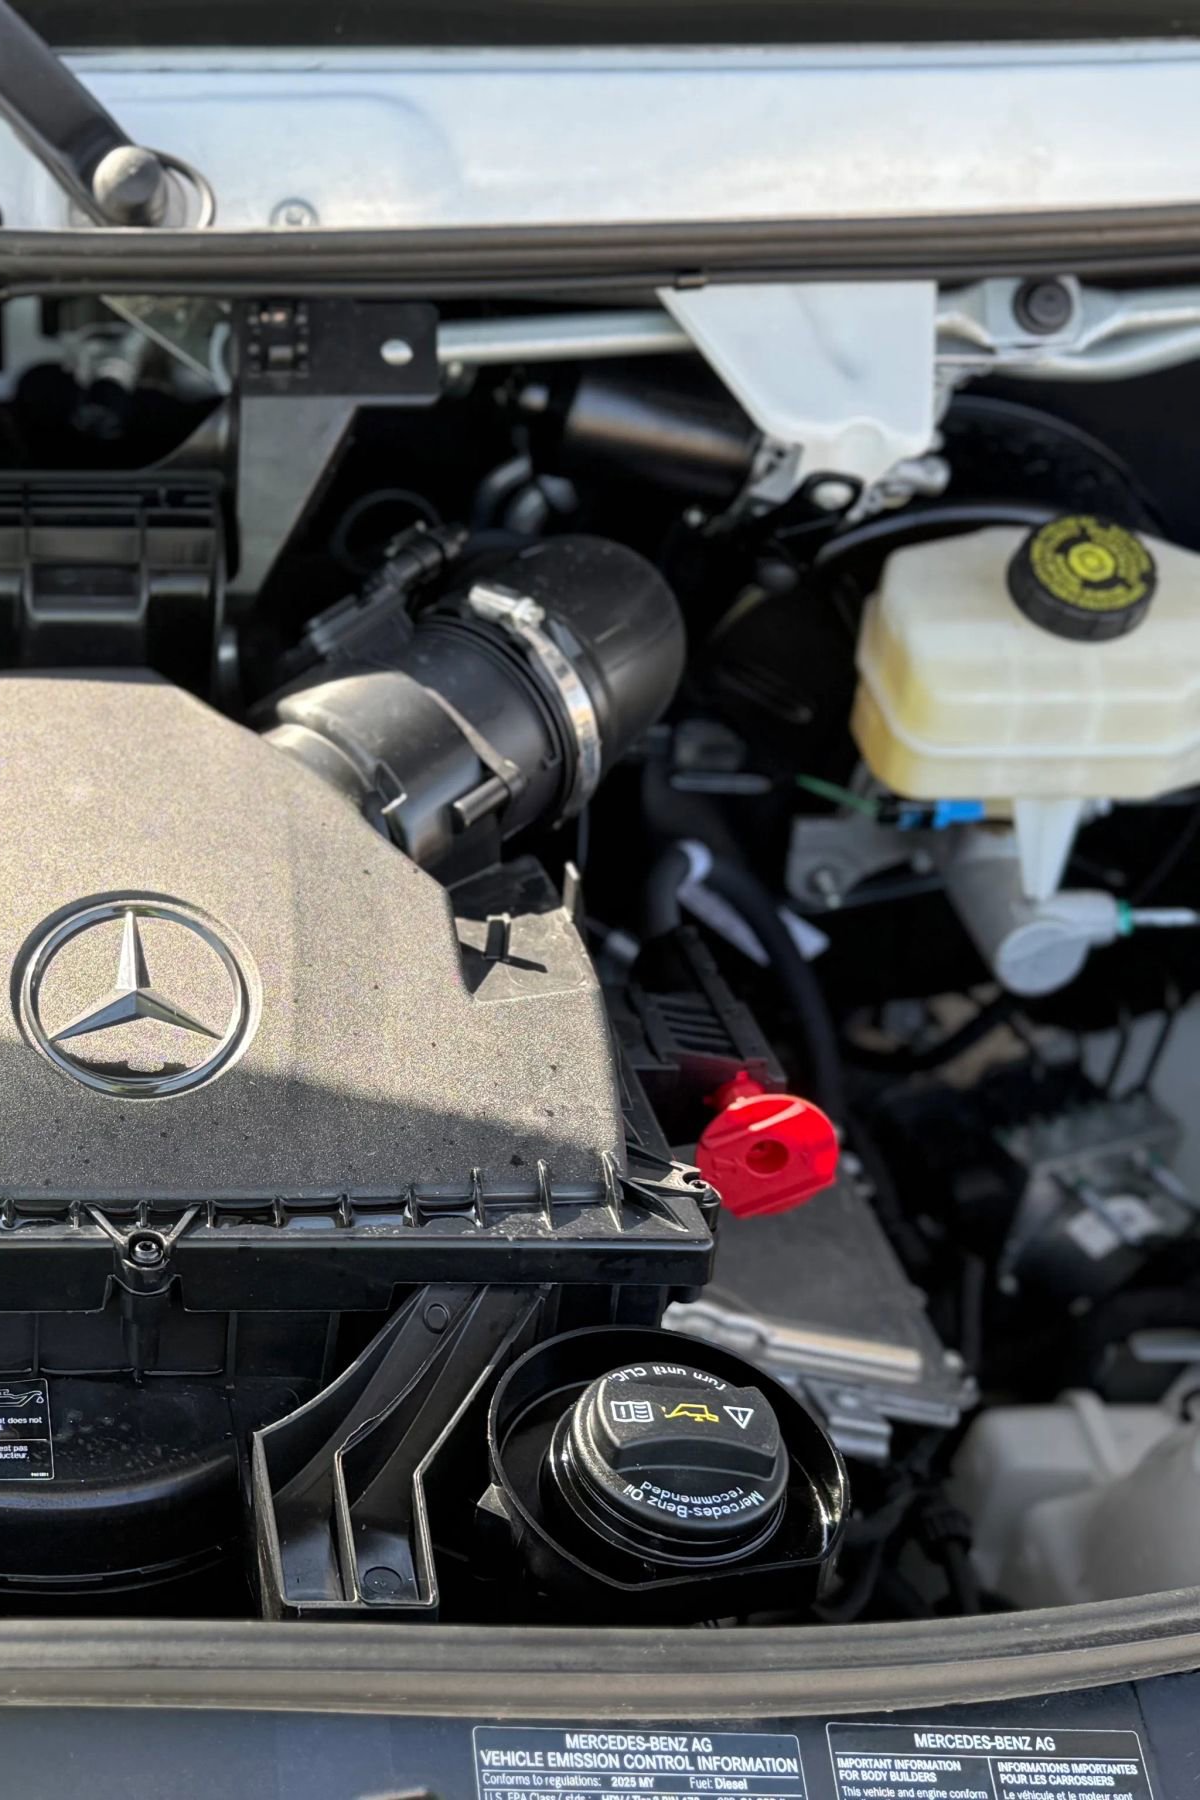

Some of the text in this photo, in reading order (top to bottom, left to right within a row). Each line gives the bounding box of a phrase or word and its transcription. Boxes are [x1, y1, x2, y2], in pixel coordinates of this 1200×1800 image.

[653, 1366, 686, 1376] until
[640, 1481, 743, 1504] recommended
[623, 1484, 765, 1519] Mercedes-Benz Oil
[565, 1733, 712, 1751] MERCEDES-BENZ AG
[914, 1733, 1055, 1751] MERCEDES-BENZ AG
[480, 1750, 798, 1773] VEHICLE EMISSION CONTROL INFORMATION
[837, 1757, 961, 1771] IMPORTANT INFORMATION
[997, 1761, 1137, 1775] INFORMATIONS IMPORTANTES
[482, 1772, 601, 1790] Conforms to regulations:
[611, 1776, 654, 1788] 2025 MY
[839, 1769, 936, 1782] FOR BODY BUILDERS
[1000, 1774, 1114, 1786] POUR LES CARROSSIERS
[689, 1777, 747, 1789] Fuel: Diesel
[841, 1785, 987, 1800] This vehicle and engine conform
[1003, 1789, 1014, 1800] Le
[1017, 1789, 1054, 1800] véhicule
[1056, 1790, 1065, 1800] et
[1068, 1791, 1076, 1800] le
[1078, 1791, 1110, 1800] moteur
